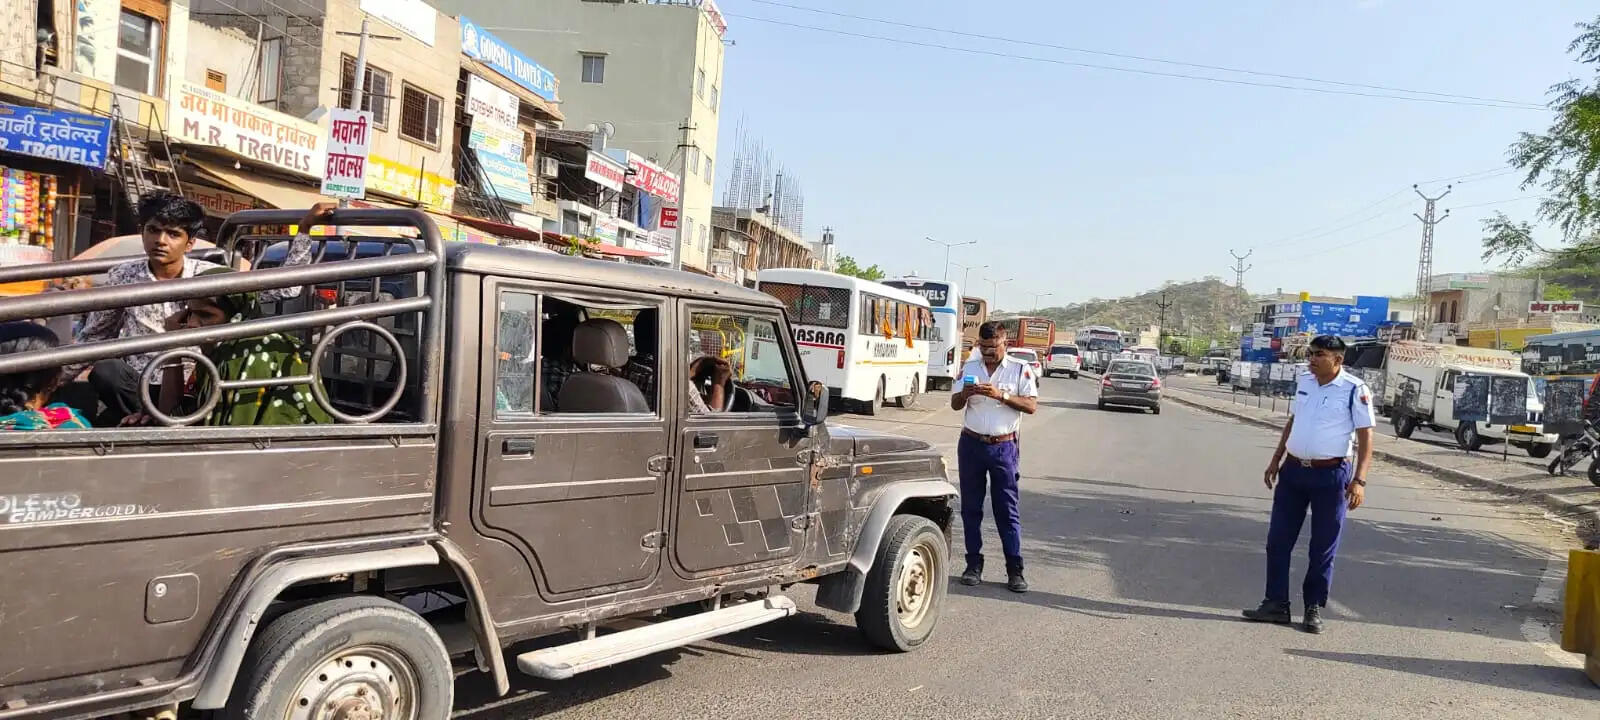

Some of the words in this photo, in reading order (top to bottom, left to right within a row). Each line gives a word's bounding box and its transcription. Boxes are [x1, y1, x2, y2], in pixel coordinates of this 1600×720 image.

[513, 54, 542, 89] TRAVELS
[180, 93, 208, 116] जय
[39, 119, 102, 147] ट्रावेल्स
[183, 116, 228, 147] M.R.
[236, 133, 312, 172] TRAVELS
[332, 115, 367, 145] भवानी
[20, 140, 100, 167] TRAVELS
[326, 146, 365, 180] ट्रावेल्स
